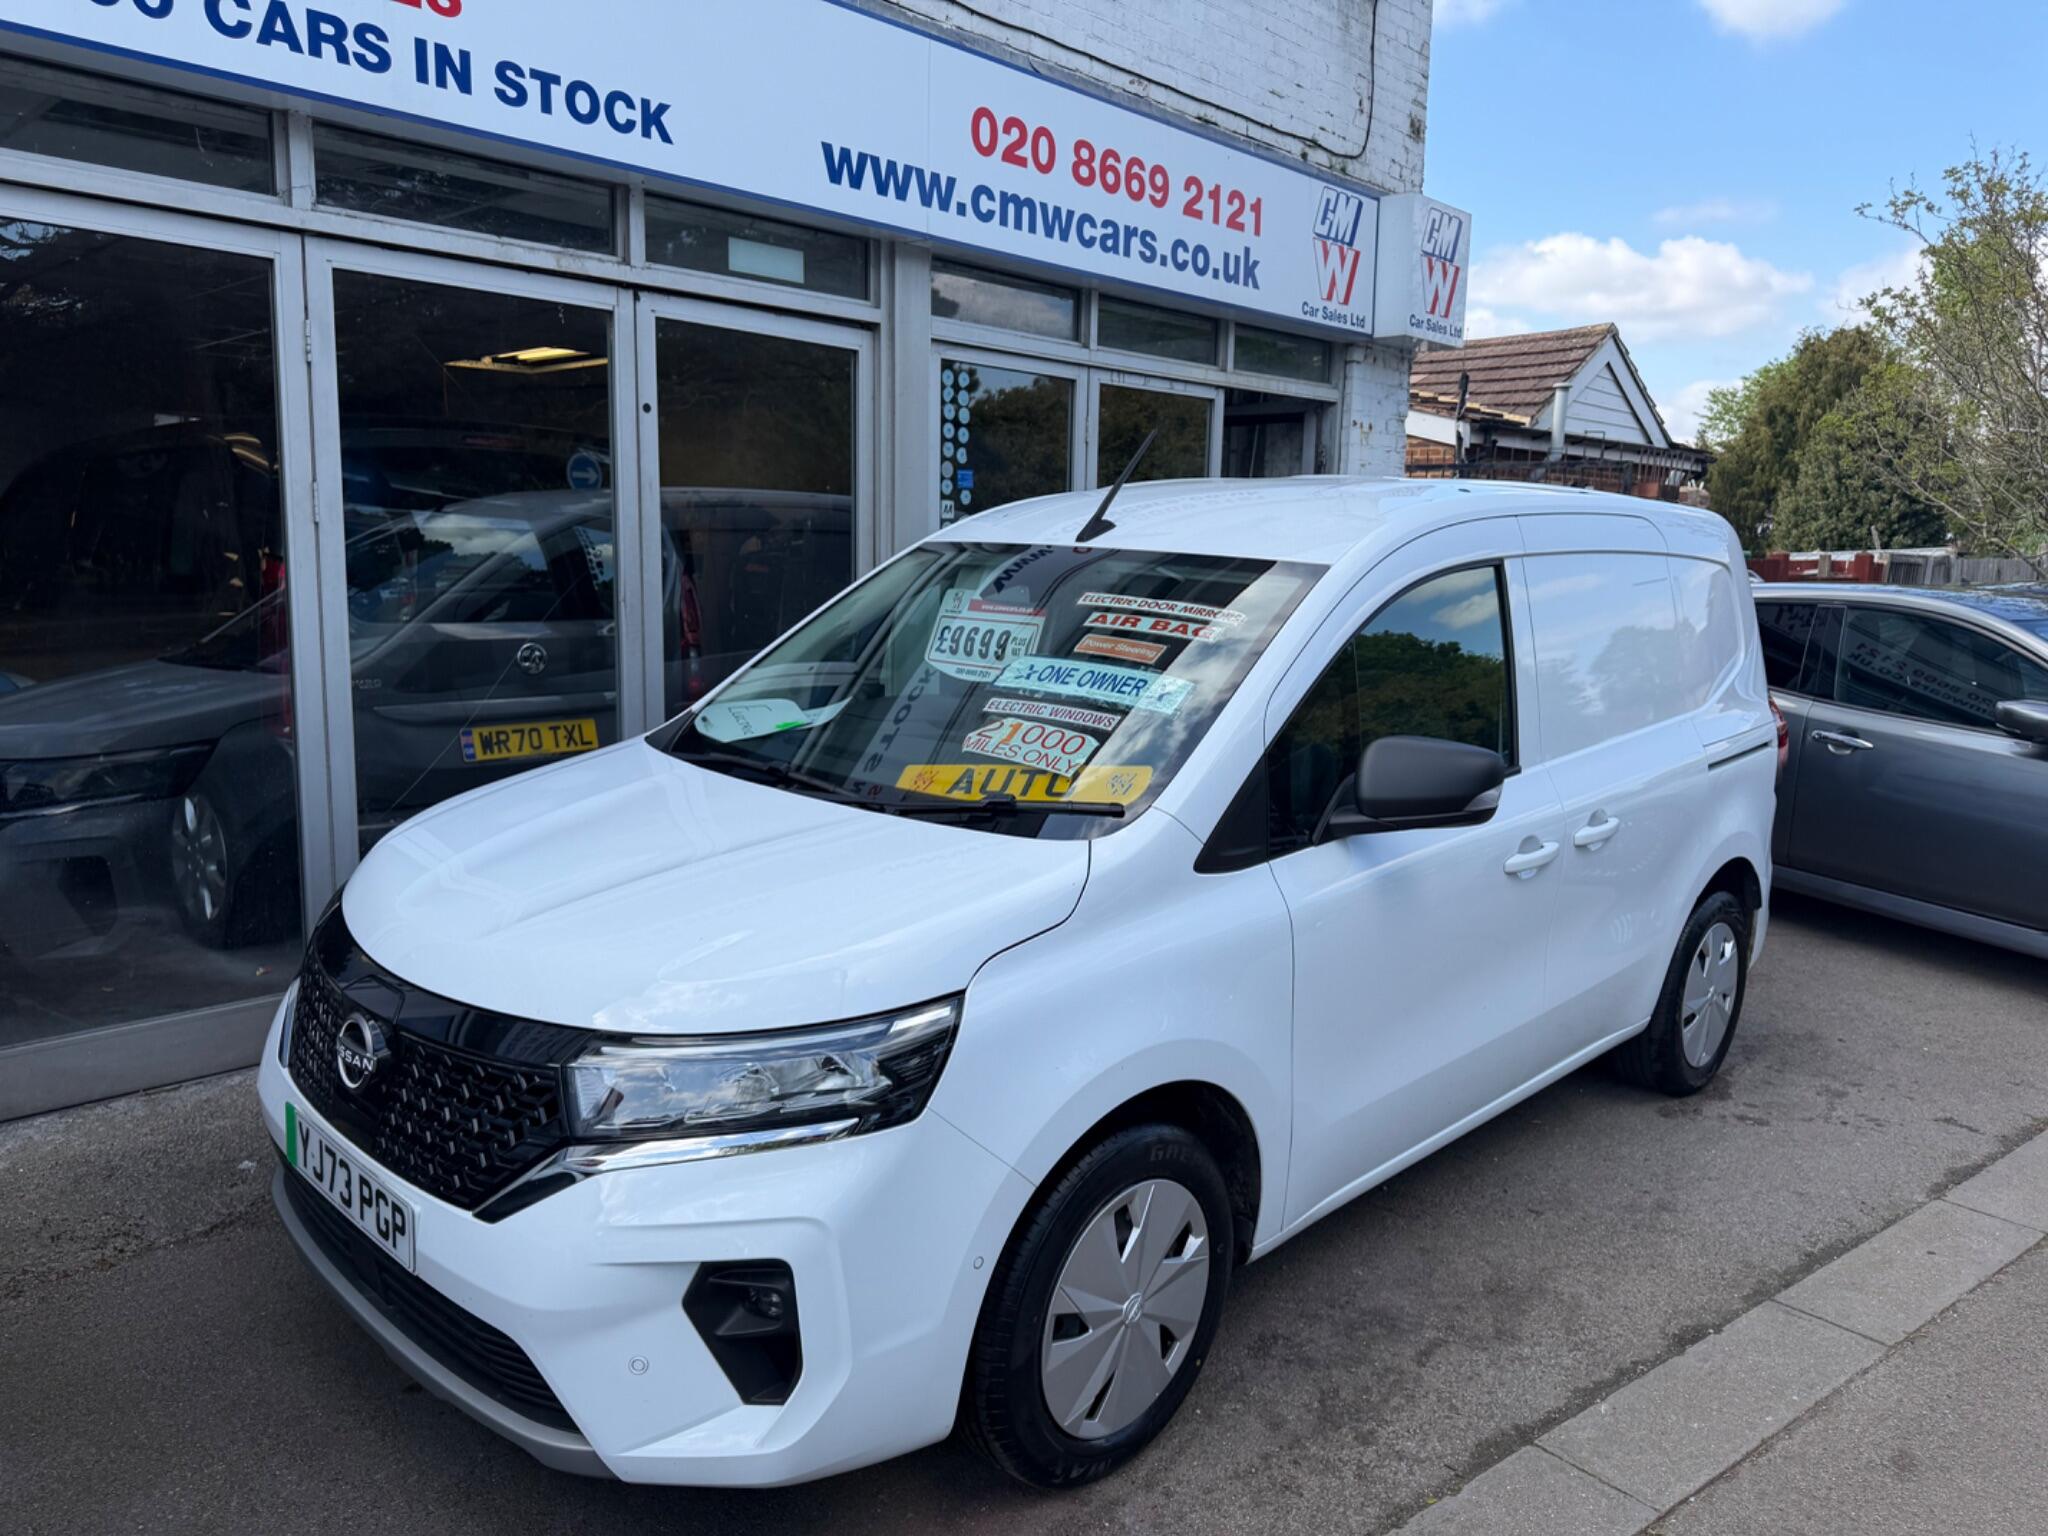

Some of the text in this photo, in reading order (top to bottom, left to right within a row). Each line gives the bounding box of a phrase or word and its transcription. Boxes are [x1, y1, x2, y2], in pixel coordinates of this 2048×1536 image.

[204, 0, 674, 145] CARS IN STOCK
[970, 106, 1263, 237] 020 8669 2121
[820, 140, 1260, 290] www.cmwcars.co.uk
[1301, 301, 1366, 329] Car Sales Ltd
[1409, 314, 1462, 338] Car Sales Ltd
[1088, 614, 1142, 629] AIR
[1138, 599, 1178, 612] DOOR
[935, 625, 1012, 662] £9699
[1037, 664, 1148, 697] ONE OWNER
[988, 700, 1115, 728] ELECTRIC WINDOWS
[479, 723, 593, 755] WR70 TXL
[976, 719, 1086, 755] 21000
[964, 736, 1081, 773] MILES ONLY
[298, 1120, 406, 1249] YJ73 PGP
